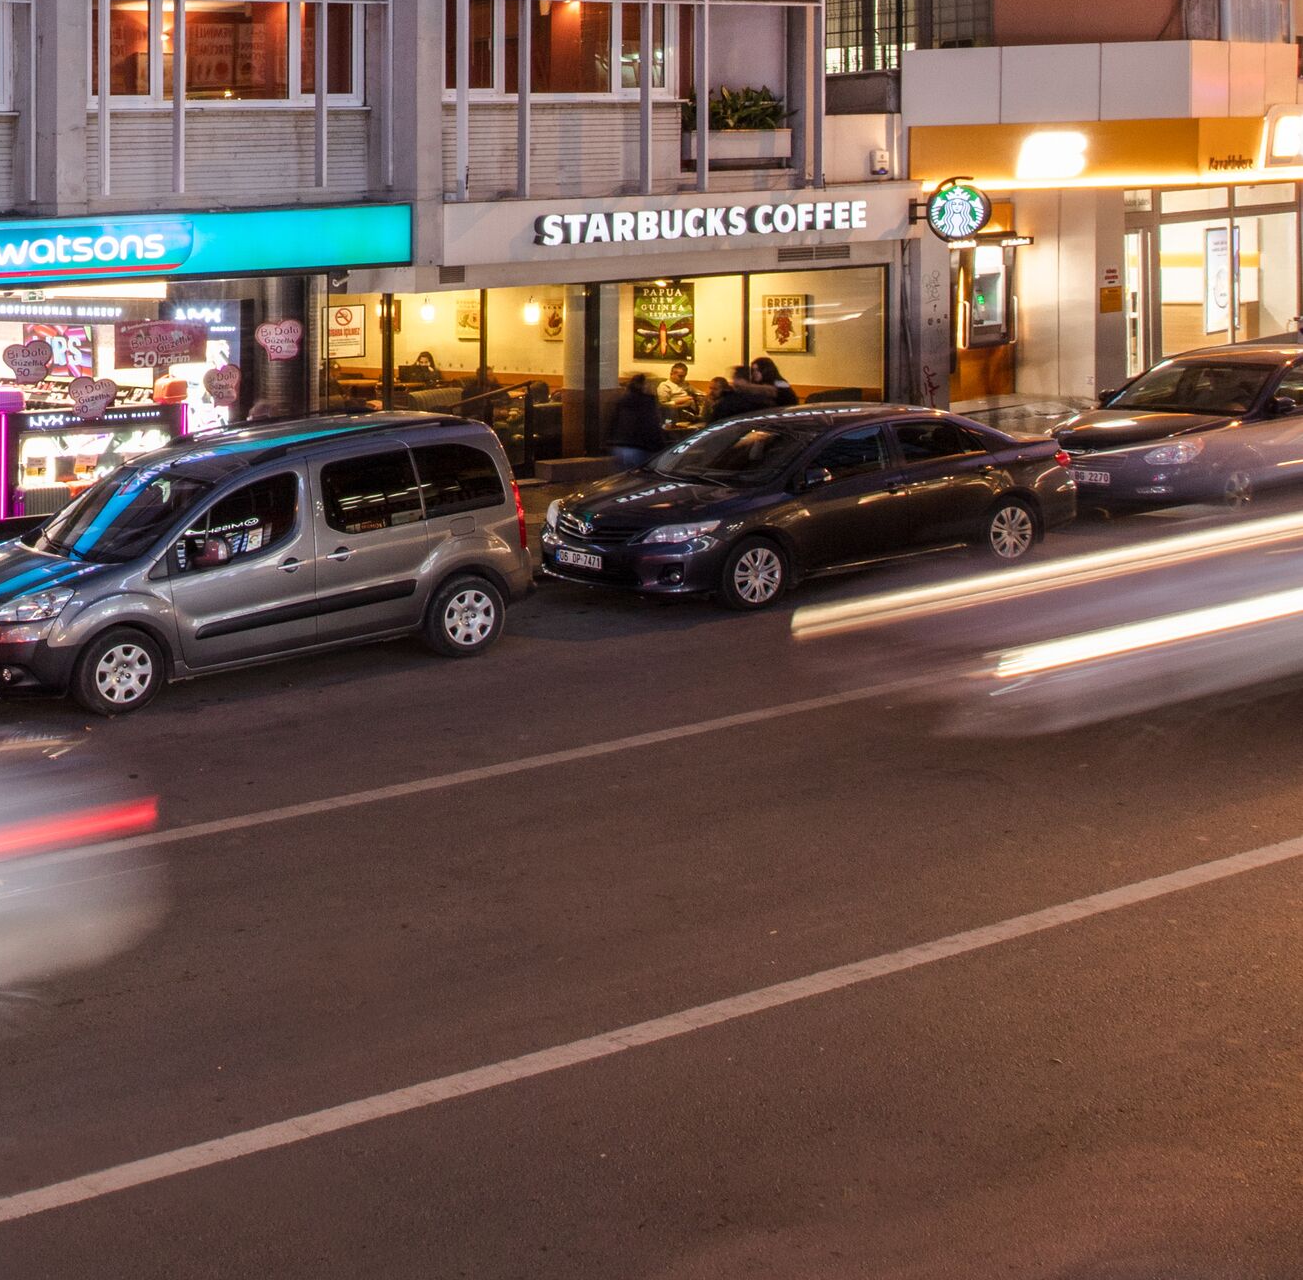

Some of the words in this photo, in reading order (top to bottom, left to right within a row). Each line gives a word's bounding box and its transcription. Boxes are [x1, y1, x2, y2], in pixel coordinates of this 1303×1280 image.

[542, 206, 747, 246] STARBUCKS
[754, 201, 867, 234] COFFEE
[643, 288, 683, 297] PAPUA
[767, 297, 800, 308] GREEN
[77, 307, 122, 317] MAKEUP
[29, 414, 64, 428] NYX
